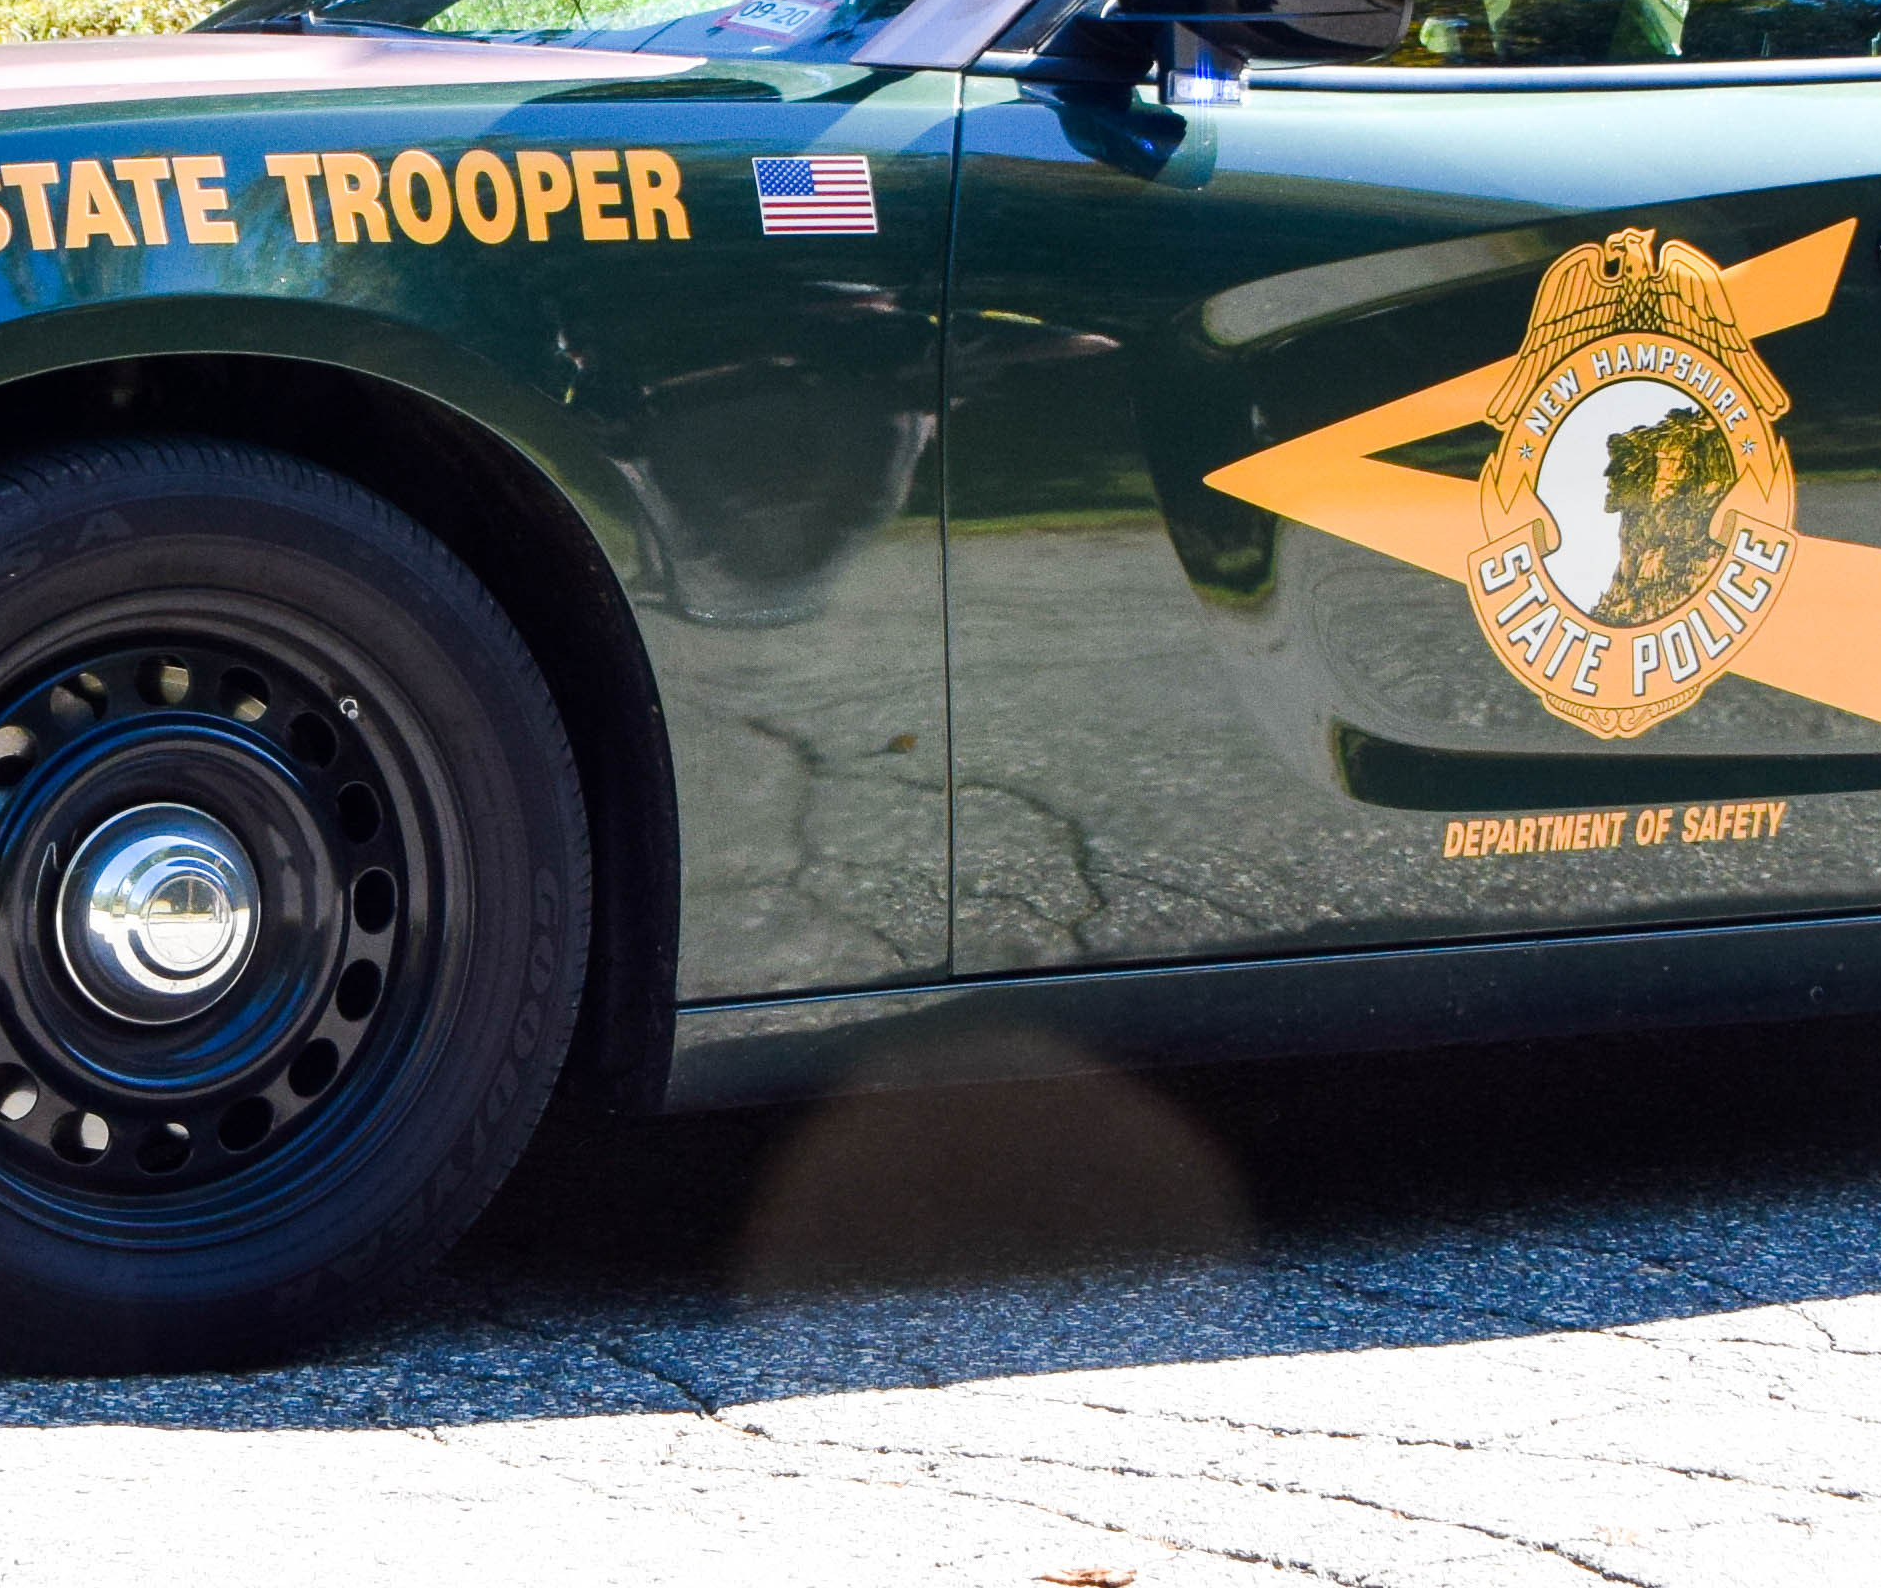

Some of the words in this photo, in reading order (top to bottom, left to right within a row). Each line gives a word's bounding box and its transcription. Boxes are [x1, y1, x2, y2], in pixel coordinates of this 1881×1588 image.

[265, 149, 691, 245] TROOPER
[1525, 365, 1582, 437] NEW
[1590, 343, 1749, 432] HAMPSHIRE
[1479, 541, 1611, 694] STATE
[1632, 529, 1787, 697] POLICE
[1443, 812, 1627, 859] DEPARTMENT
[1635, 808, 1671, 846] OF
[1681, 801, 1787, 844] SAFETY
